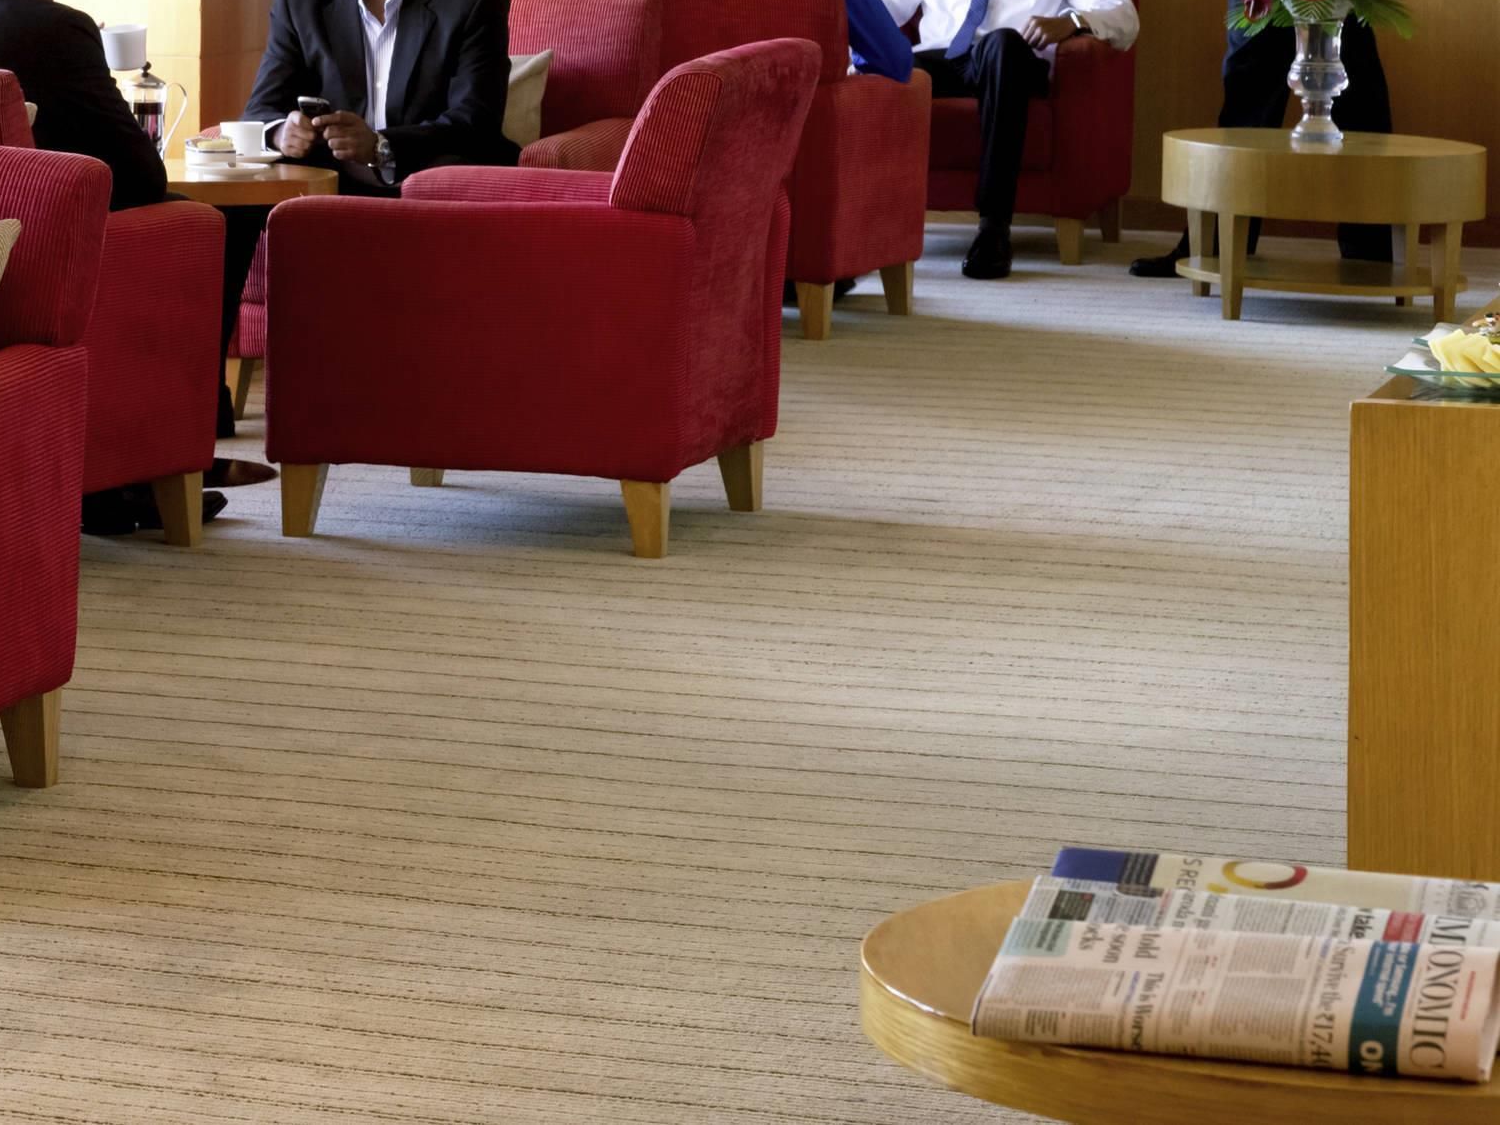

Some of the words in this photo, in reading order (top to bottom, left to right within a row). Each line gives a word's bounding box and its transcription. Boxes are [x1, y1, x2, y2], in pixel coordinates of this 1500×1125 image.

[1102, 935, 1128, 964] soon
[1133, 932, 1162, 960] told
[1145, 972, 1165, 992] This
[1319, 991, 1343, 1013] the
